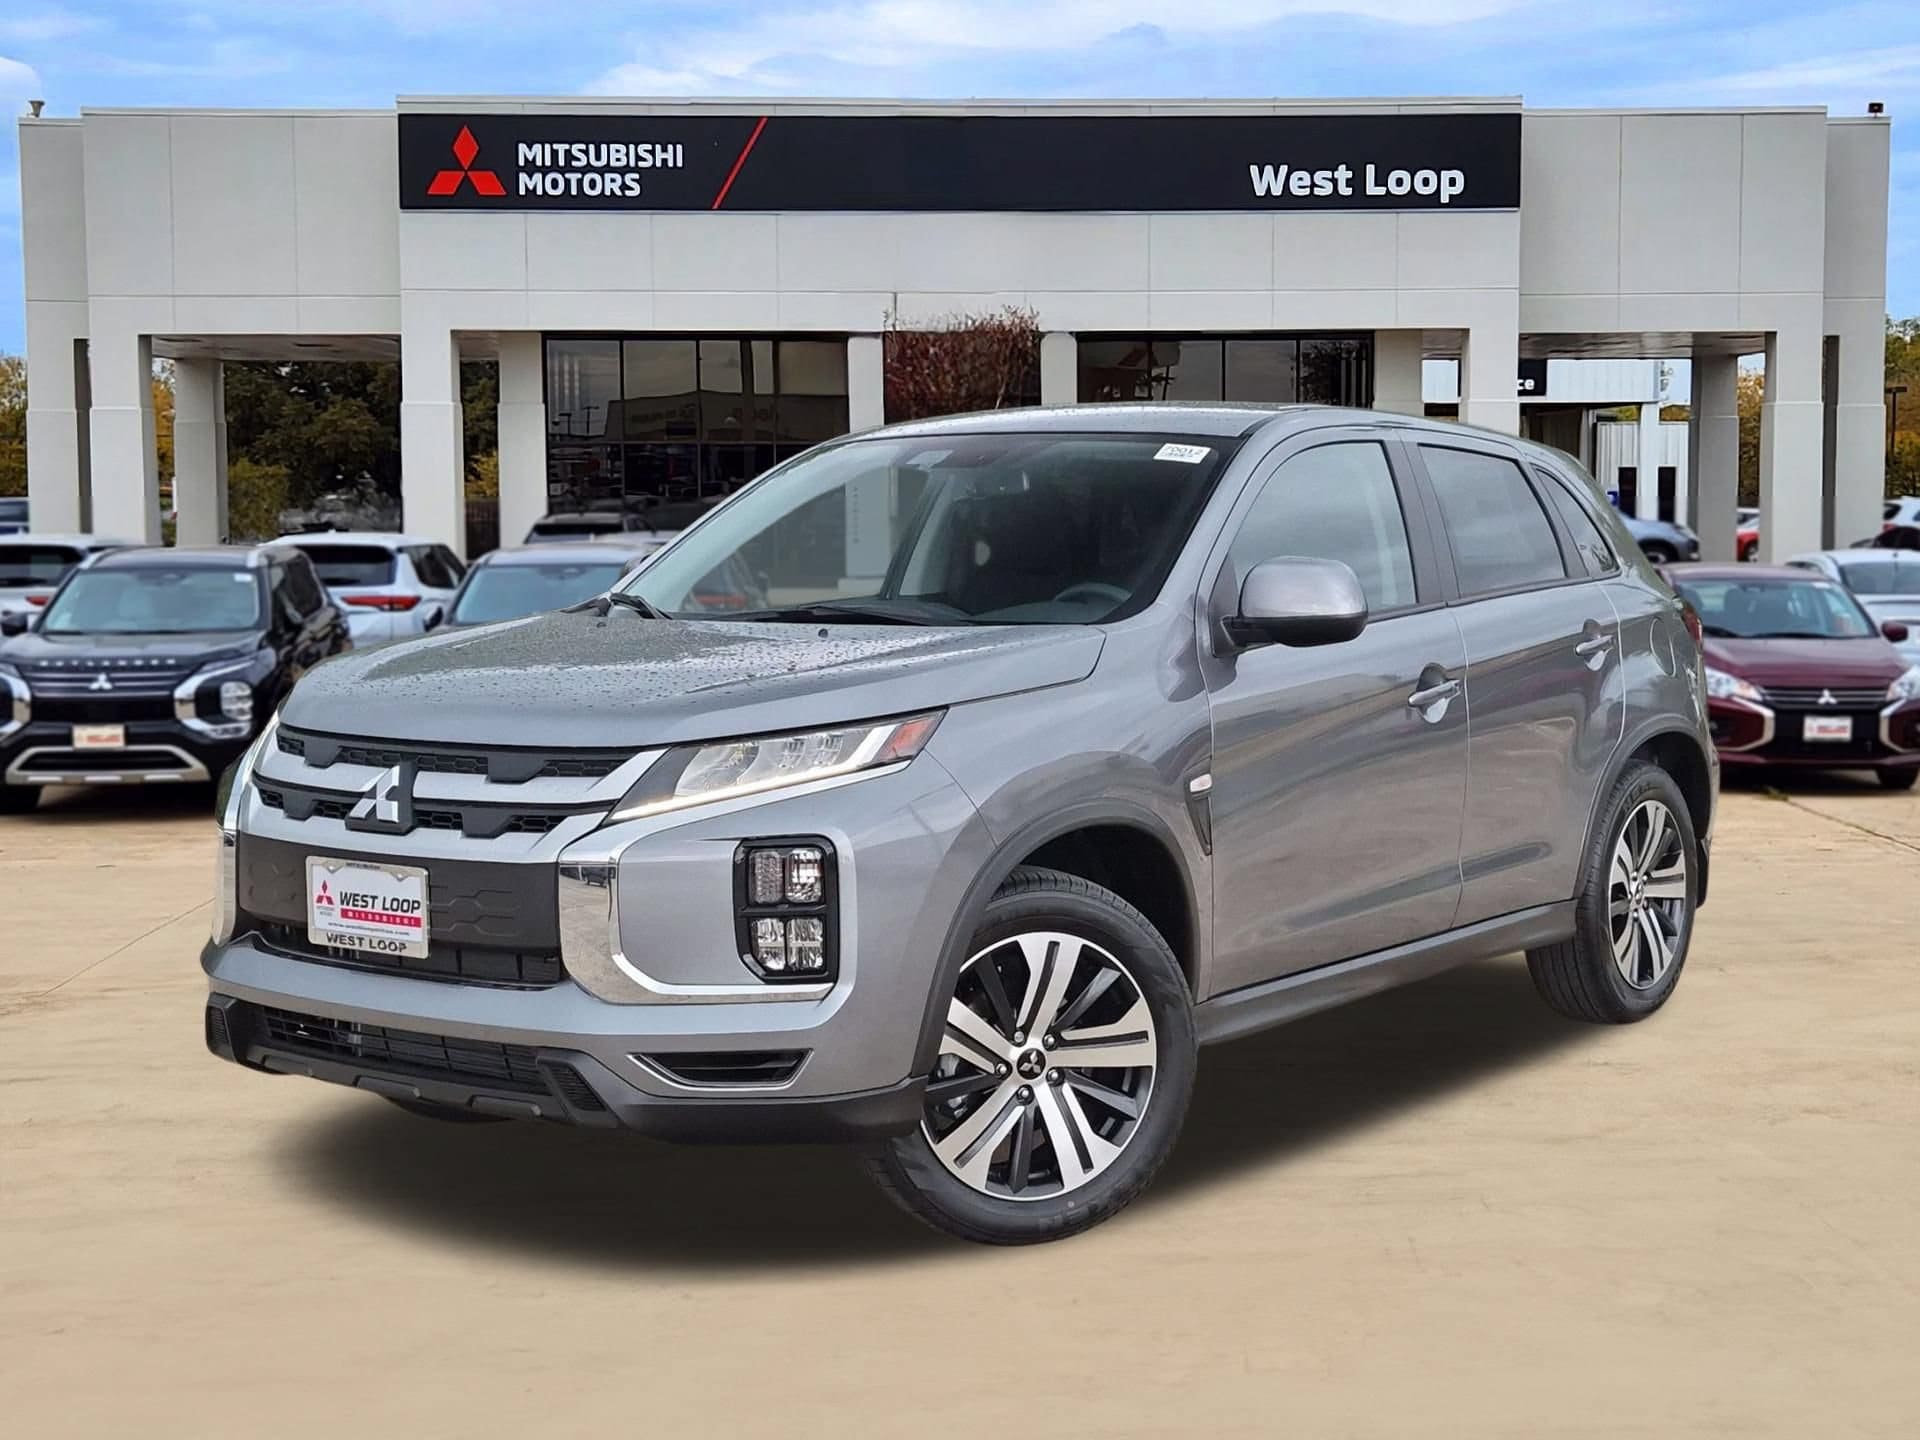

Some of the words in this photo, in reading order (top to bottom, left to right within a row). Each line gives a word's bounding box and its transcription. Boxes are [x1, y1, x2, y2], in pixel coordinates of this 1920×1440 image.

[517, 142, 684, 169] MITSUBISHI
[517, 172, 642, 197] MOTORS
[1249, 163, 1353, 197] West
[1365, 163, 1465, 204] Loop
[339, 891, 378, 909] WEST
[382, 896, 421, 914] LOOP
[326, 933, 365, 948] WEST
[369, 938, 408, 953] LOOP
